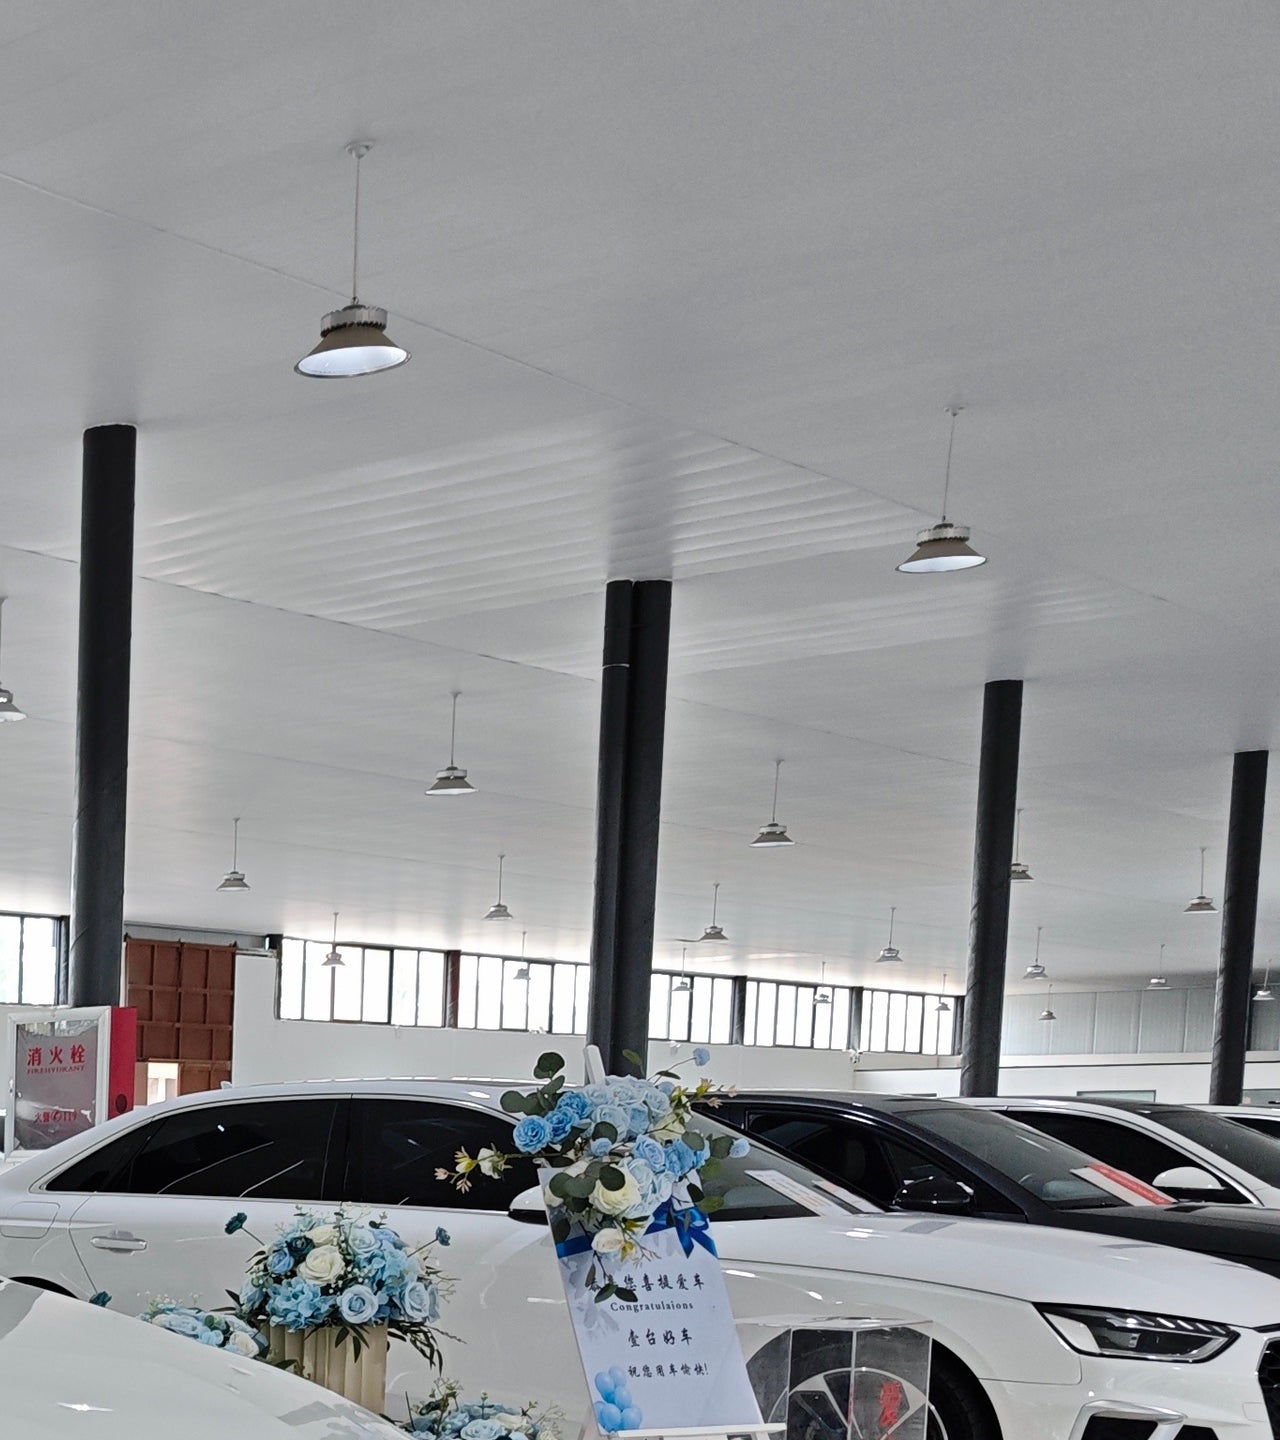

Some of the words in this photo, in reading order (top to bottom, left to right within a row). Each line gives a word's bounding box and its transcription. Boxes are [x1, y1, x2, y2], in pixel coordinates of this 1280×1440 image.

[27, 1044, 86, 1067] 消火栓
[628, 1328, 692, 1347] 壹台好车
